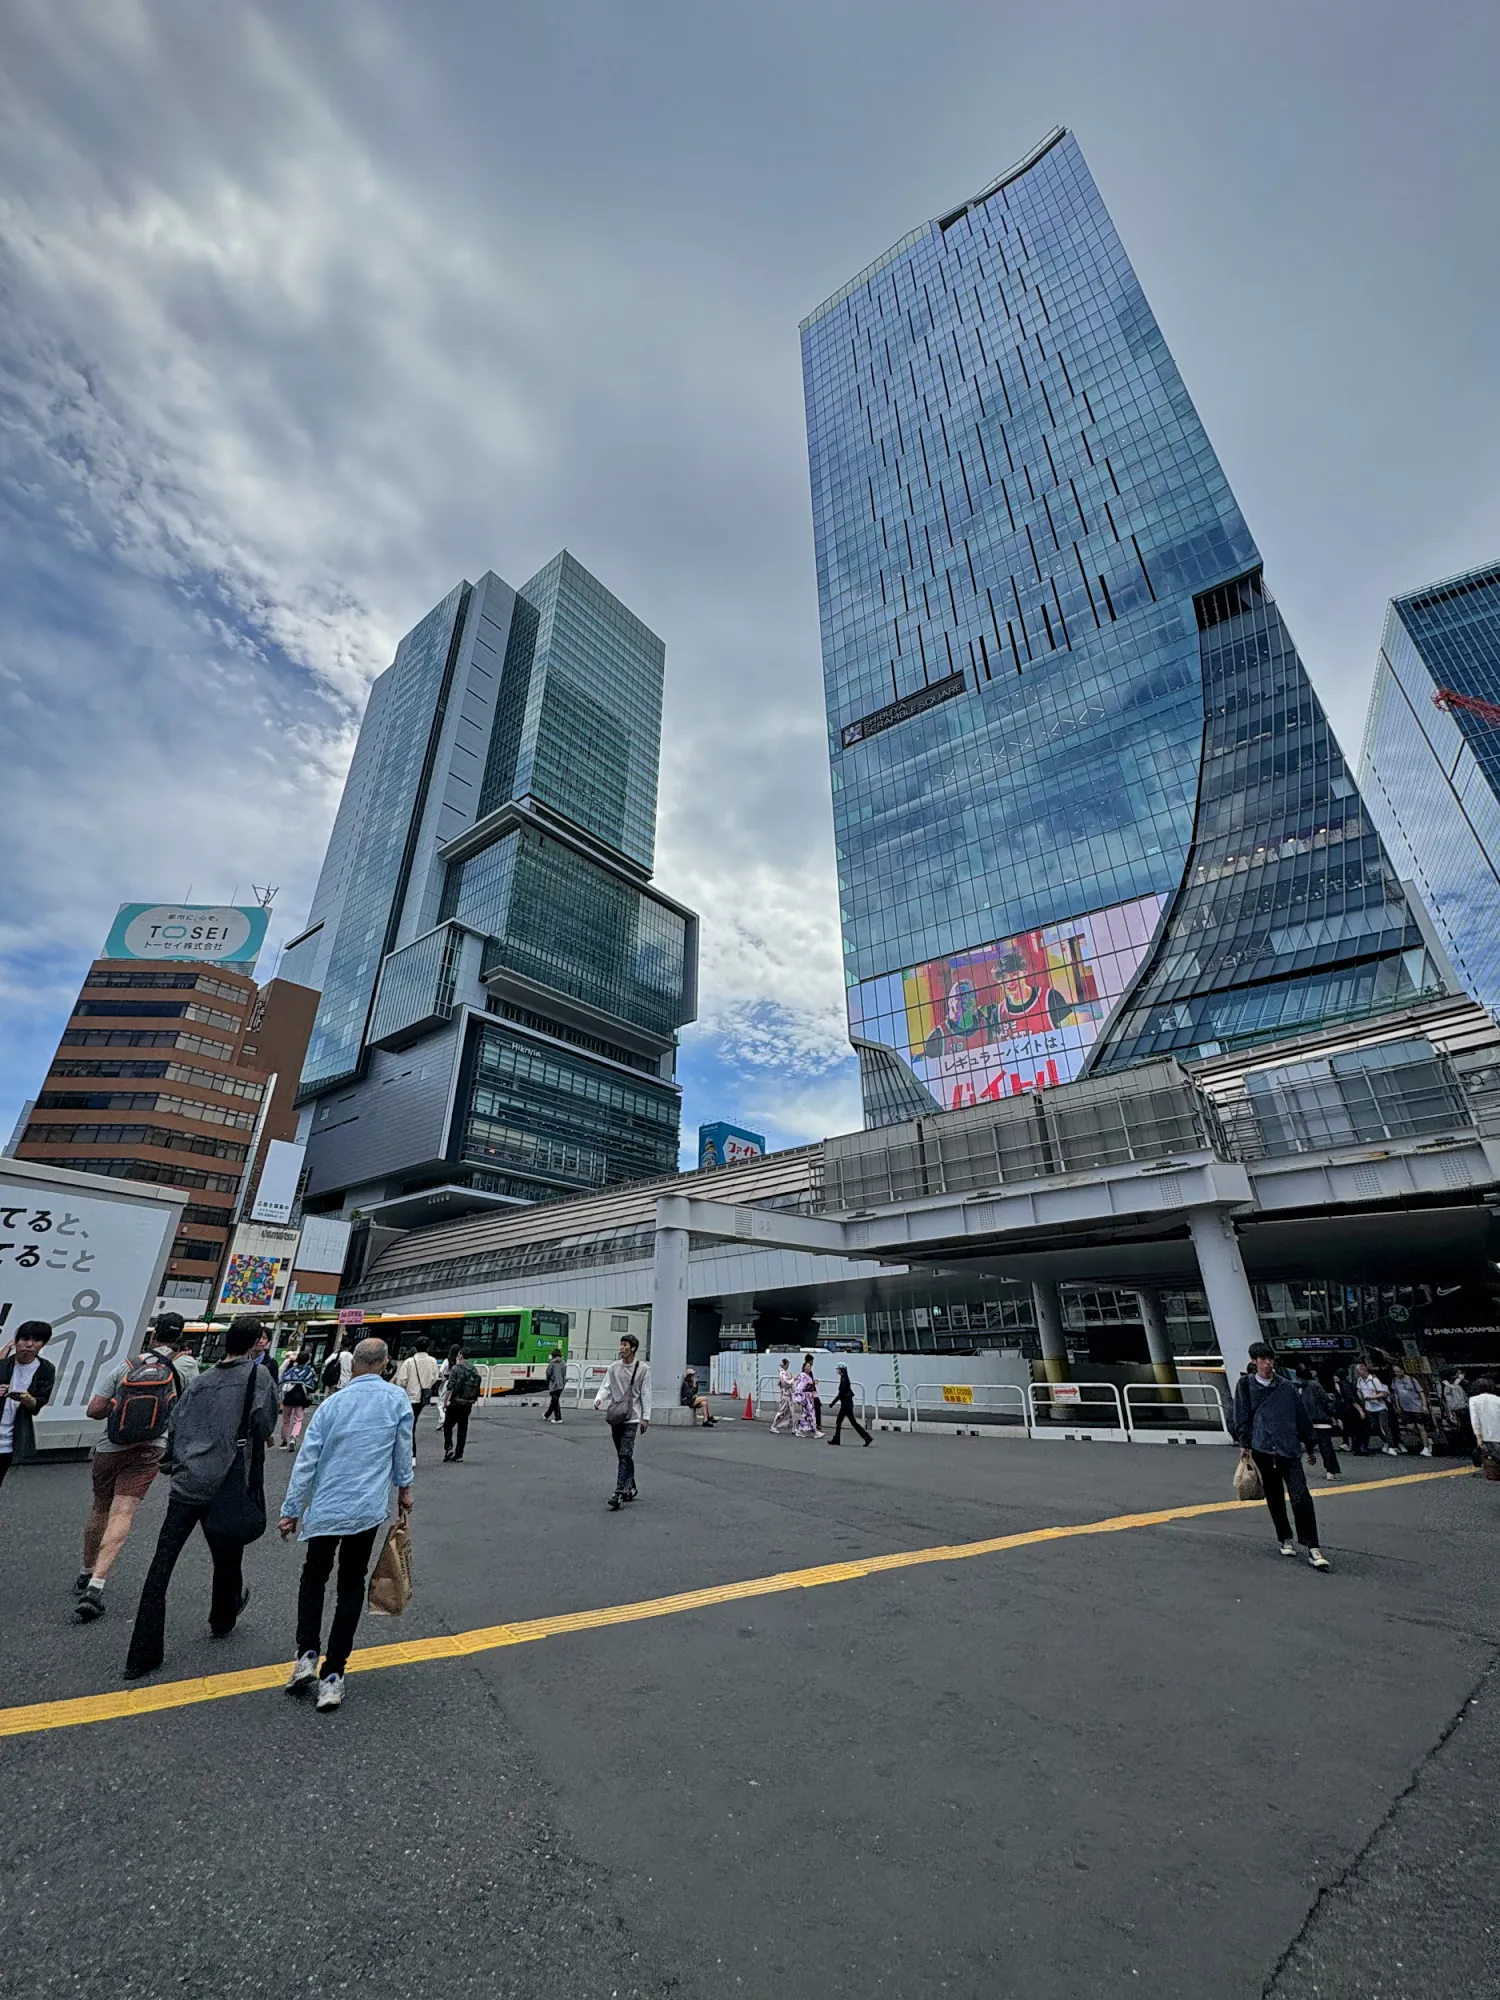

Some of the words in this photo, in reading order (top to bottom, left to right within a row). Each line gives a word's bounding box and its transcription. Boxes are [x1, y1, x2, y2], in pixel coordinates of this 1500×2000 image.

[864, 706, 917, 734] SCRAMBLE
[919, 683, 962, 710] SQUARE
[864, 702, 907, 727] SHIBUYA
[150, 925, 229, 940] TOSEI
[144, 941, 223, 950] トーセイ株式会社
[944, 1036, 1065, 1071] レギュラーバイトは、
[728, 1142, 758, 1156] ファイト
[1433, 1327, 1464, 1335] SHIBUYA
